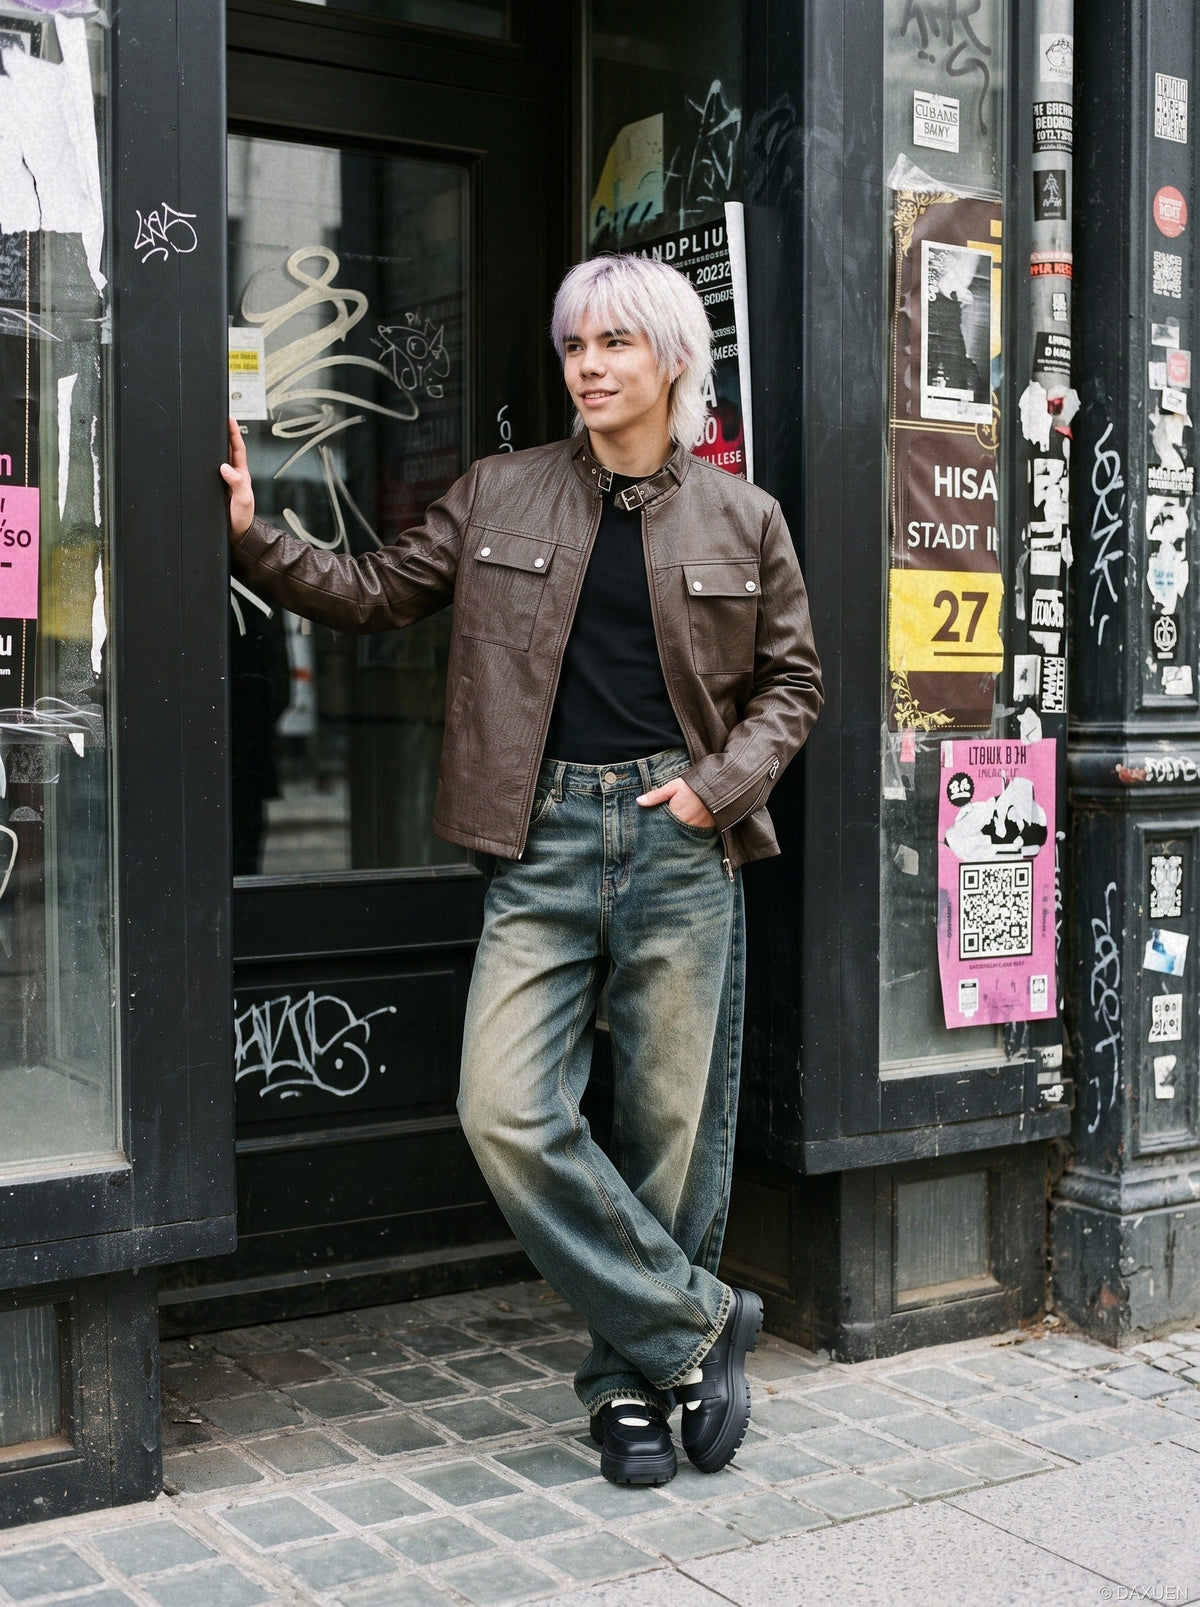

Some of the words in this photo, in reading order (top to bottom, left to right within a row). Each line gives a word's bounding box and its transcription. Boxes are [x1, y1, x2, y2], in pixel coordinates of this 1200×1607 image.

[632, 226, 729, 264] ANDPLIU
[711, 343, 739, 362] MEES
[933, 465, 998, 501] HISA
[907, 521, 978, 550] STADT
[931, 589, 989, 643] 27
